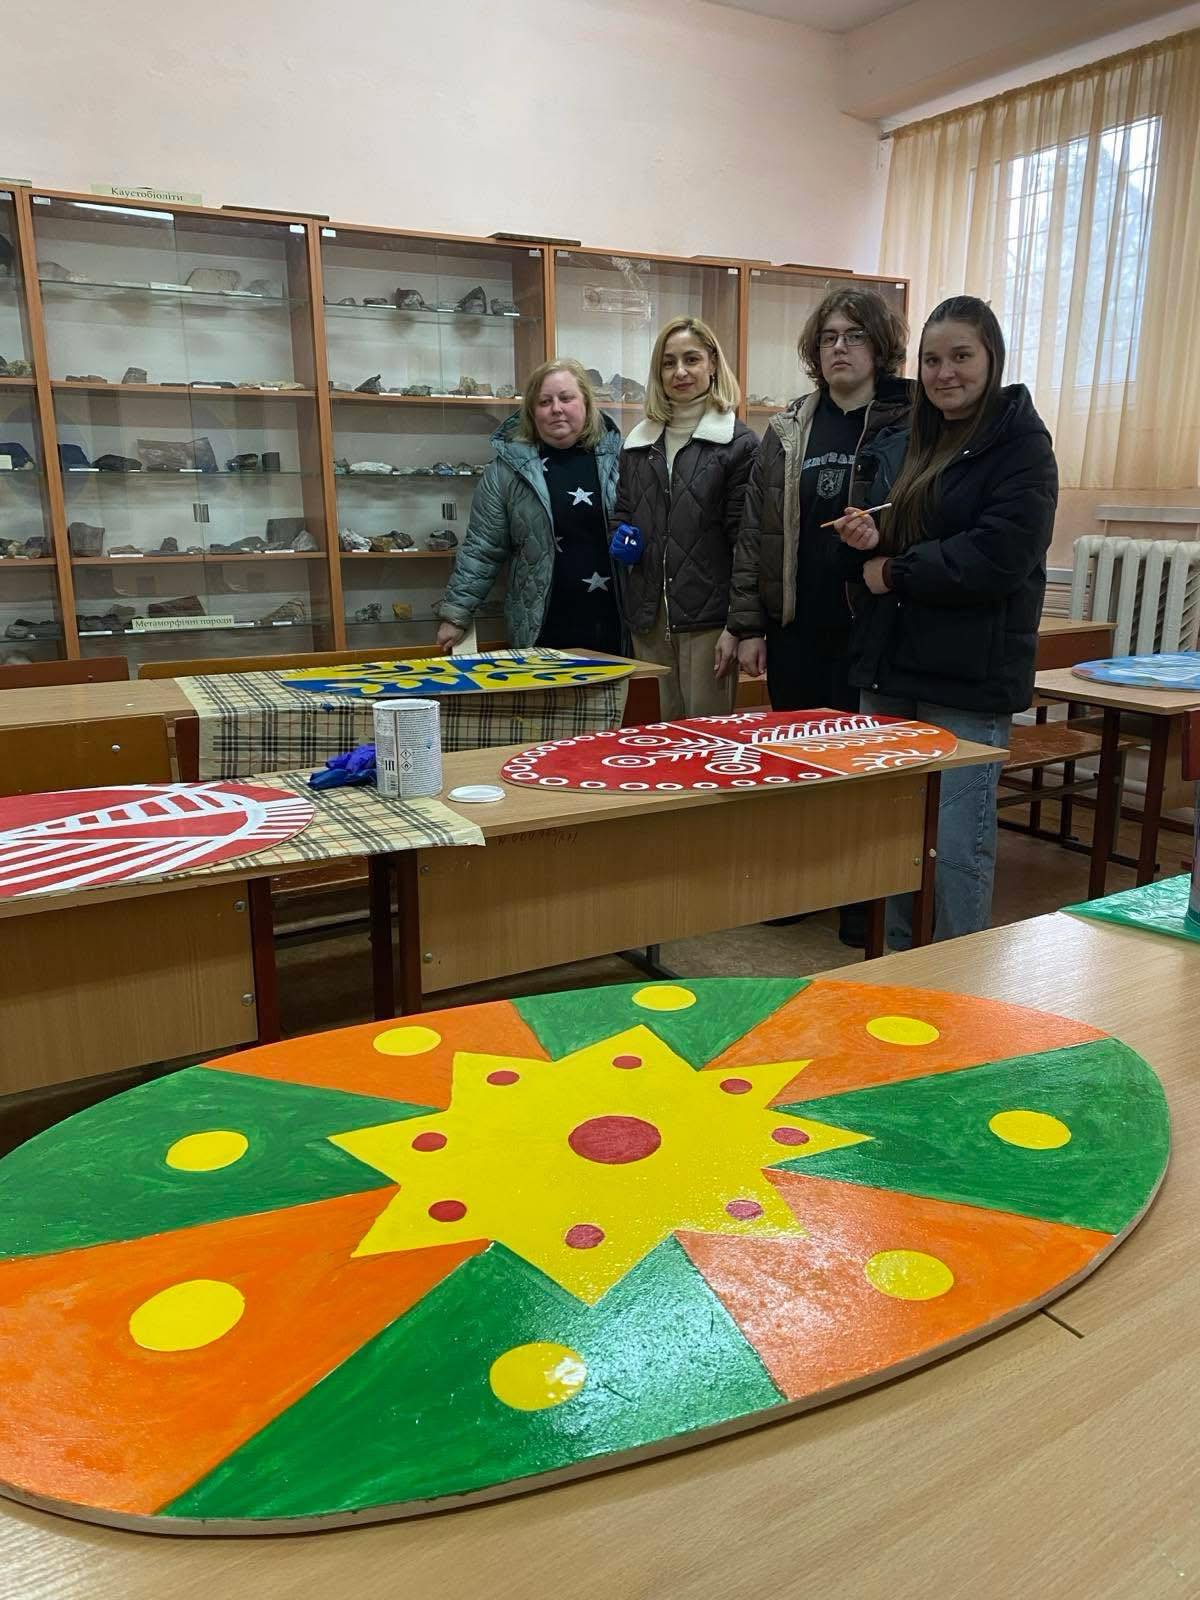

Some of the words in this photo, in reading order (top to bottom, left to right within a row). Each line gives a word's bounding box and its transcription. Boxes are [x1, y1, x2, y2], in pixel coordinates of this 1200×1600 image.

[111, 187, 183, 201] Каустобіоліти
[135, 617, 198, 629] Метаморфічні
[200, 617, 232, 627] породи
